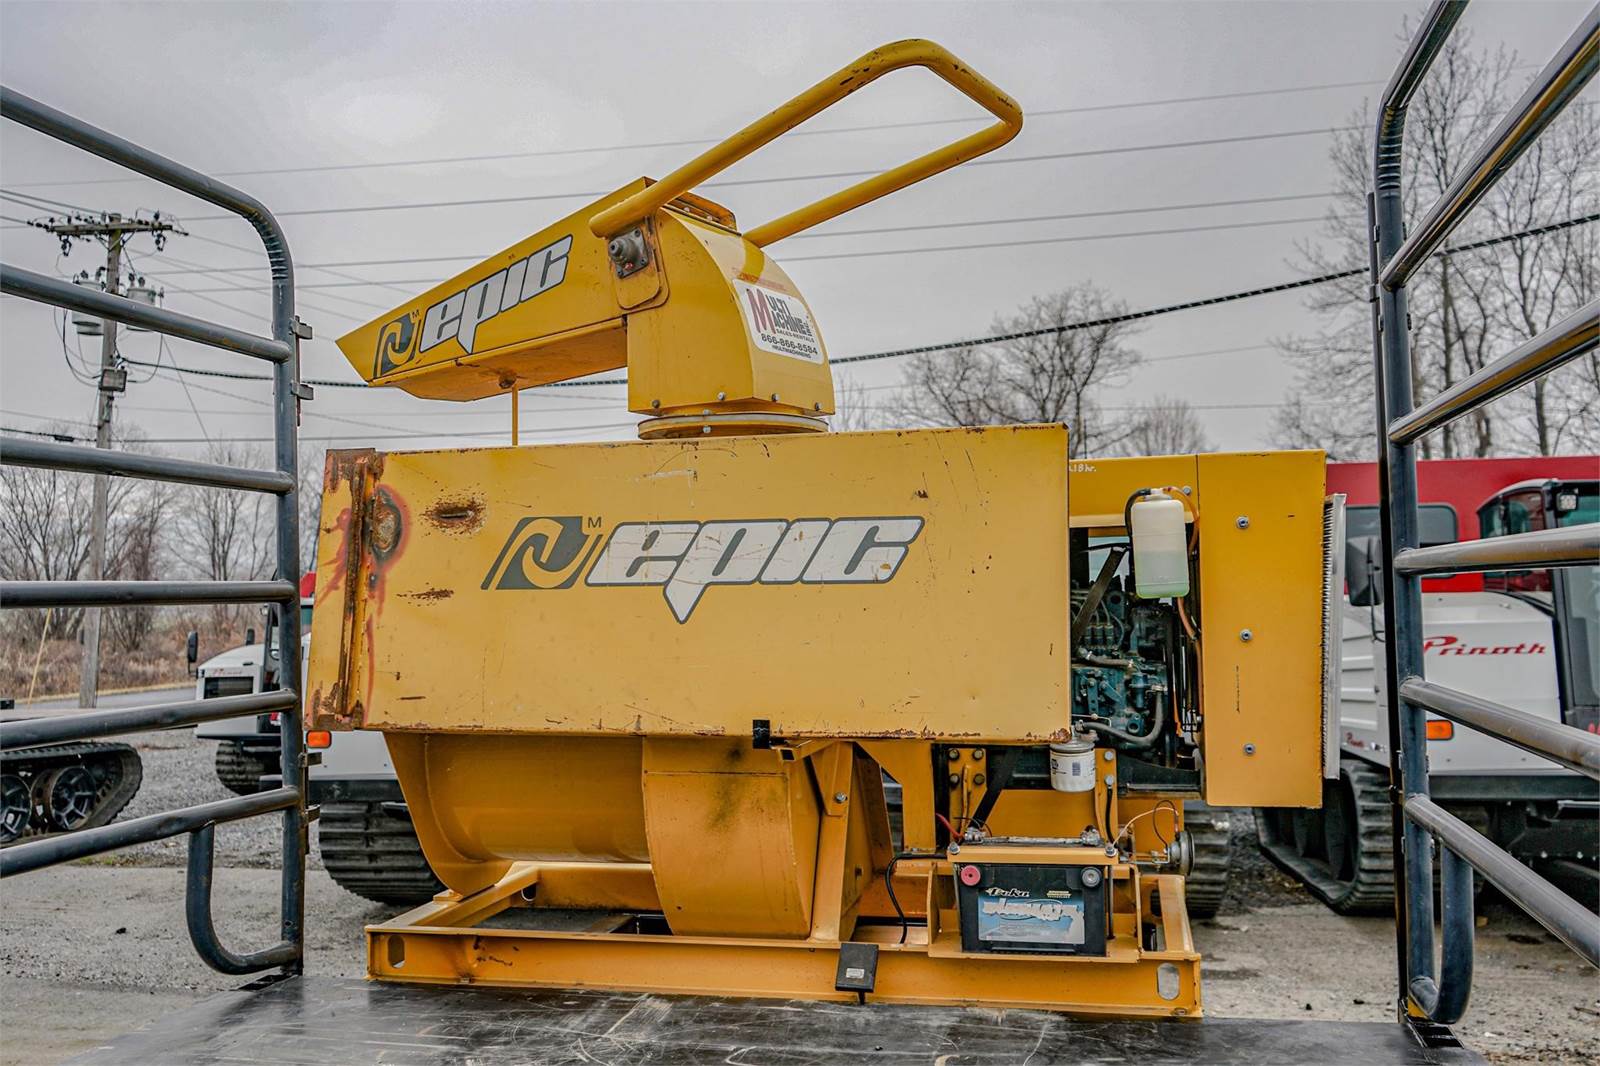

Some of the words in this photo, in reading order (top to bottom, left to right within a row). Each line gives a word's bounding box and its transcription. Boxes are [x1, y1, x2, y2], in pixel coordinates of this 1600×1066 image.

[420, 234, 573, 355] epic
[761, 333, 818, 355] 866-866-8584
[584, 516, 925, 625] epic
[1424, 636, 1547, 656] Prinoth
